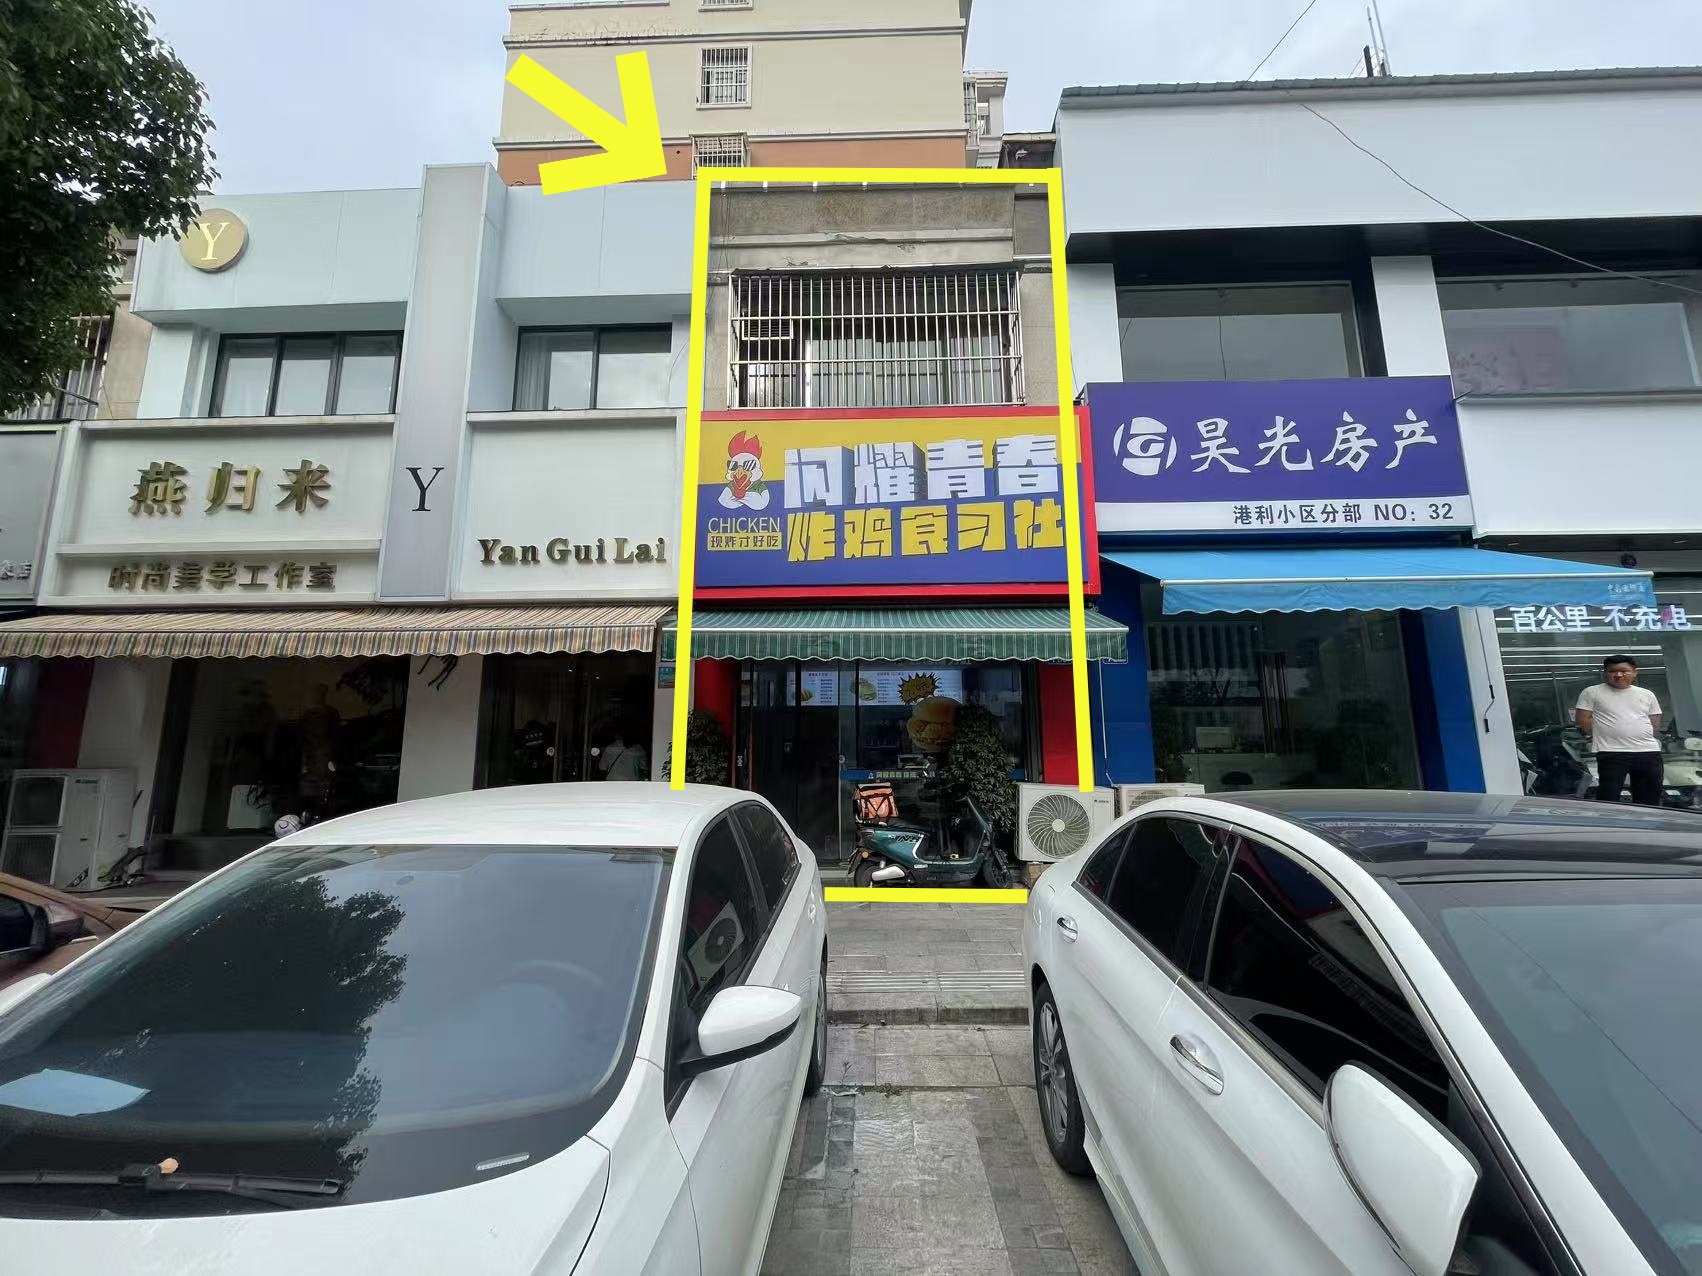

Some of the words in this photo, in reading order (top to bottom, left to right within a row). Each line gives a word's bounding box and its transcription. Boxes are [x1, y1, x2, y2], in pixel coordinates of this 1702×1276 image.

[199, 222, 231, 261] Y
[1190, 408, 1438, 475] 昊光房产
[127, 459, 332, 516] 燕归来
[405, 466, 445, 512] Y
[784, 434, 1059, 509] 闪耀青春
[708, 516, 780, 533] CHICKEN
[787, 498, 1065, 562] 炸鸡食习社
[1233, 502, 1362, 525] 港利小区分部
[1429, 502, 1454, 520] 32
[478, 537, 541, 565] Yan
[546, 537, 607, 564] Gui
[613, 536, 667, 564] Lai
[710, 534, 780, 549] 现炸才好吃
[108, 561, 338, 593] 时尚美学工作室
[1510, 604, 1592, 633] 百公里
[1602, 603, 1692, 632] 不充电
